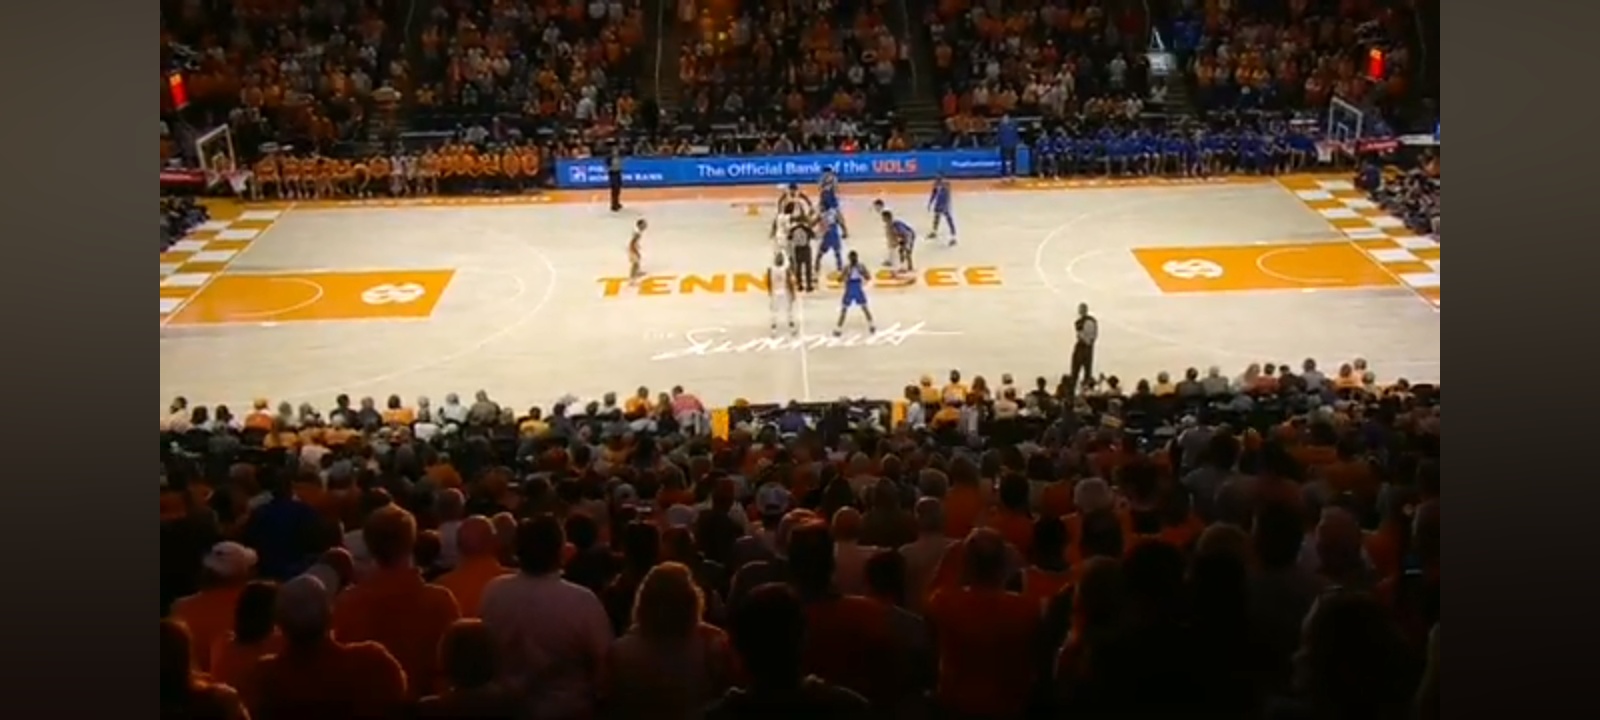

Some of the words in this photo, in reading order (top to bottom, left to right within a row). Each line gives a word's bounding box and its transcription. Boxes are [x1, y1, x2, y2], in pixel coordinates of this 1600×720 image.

[697, 163, 725, 177] The
[728, 161, 783, 177] Official
[785, 161, 821, 175] Bank
[843, 160, 868, 173] the
[872, 158, 918, 173] VOLS
[597, 267, 1002, 297] TENNSEE
